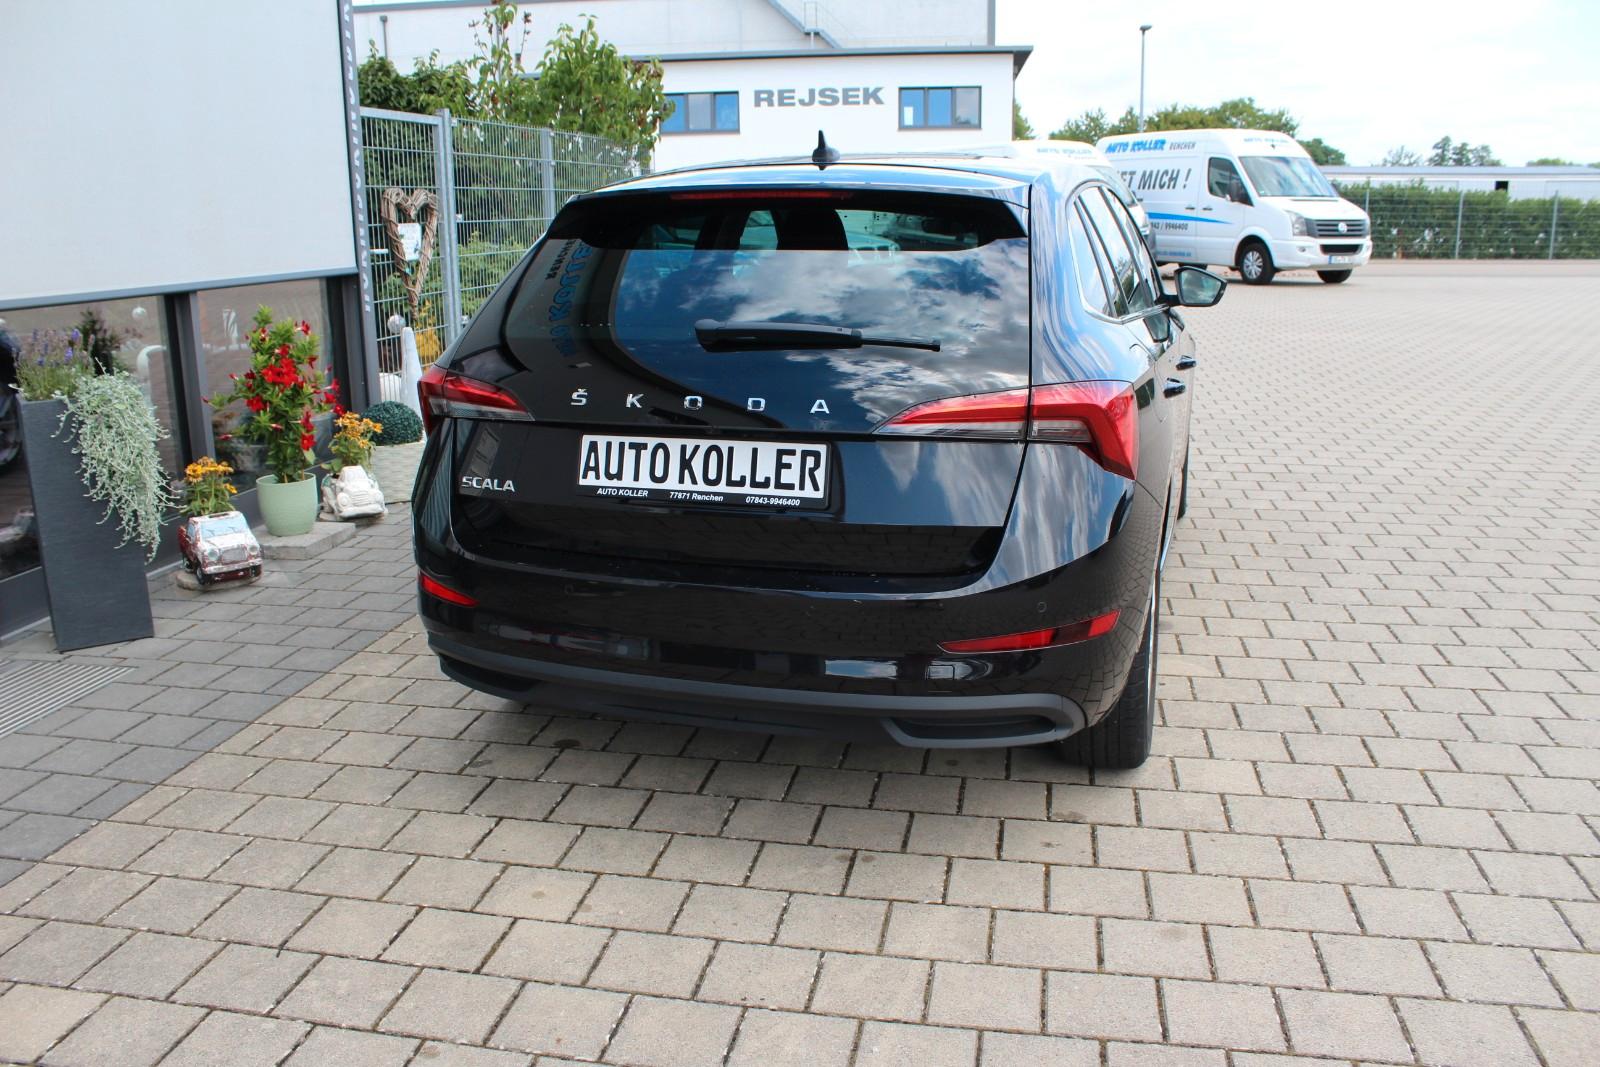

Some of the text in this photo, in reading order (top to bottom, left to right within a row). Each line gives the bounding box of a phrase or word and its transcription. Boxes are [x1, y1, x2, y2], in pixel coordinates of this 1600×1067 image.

[753, 86, 885, 107] REJSEK
[1105, 142, 1129, 153] AUTO
[1130, 139, 1166, 152] KOLLER
[1118, 170, 1136, 188] ET
[1138, 168, 1180, 190] MICH
[571, 388, 830, 414] ŠKODA
[581, 440, 822, 492] AUTO KOLLER
[461, 476, 515, 492] SCALA
[596, 487, 801, 506] AUTO KOLLER 77871 Renchen 07843-9946400
